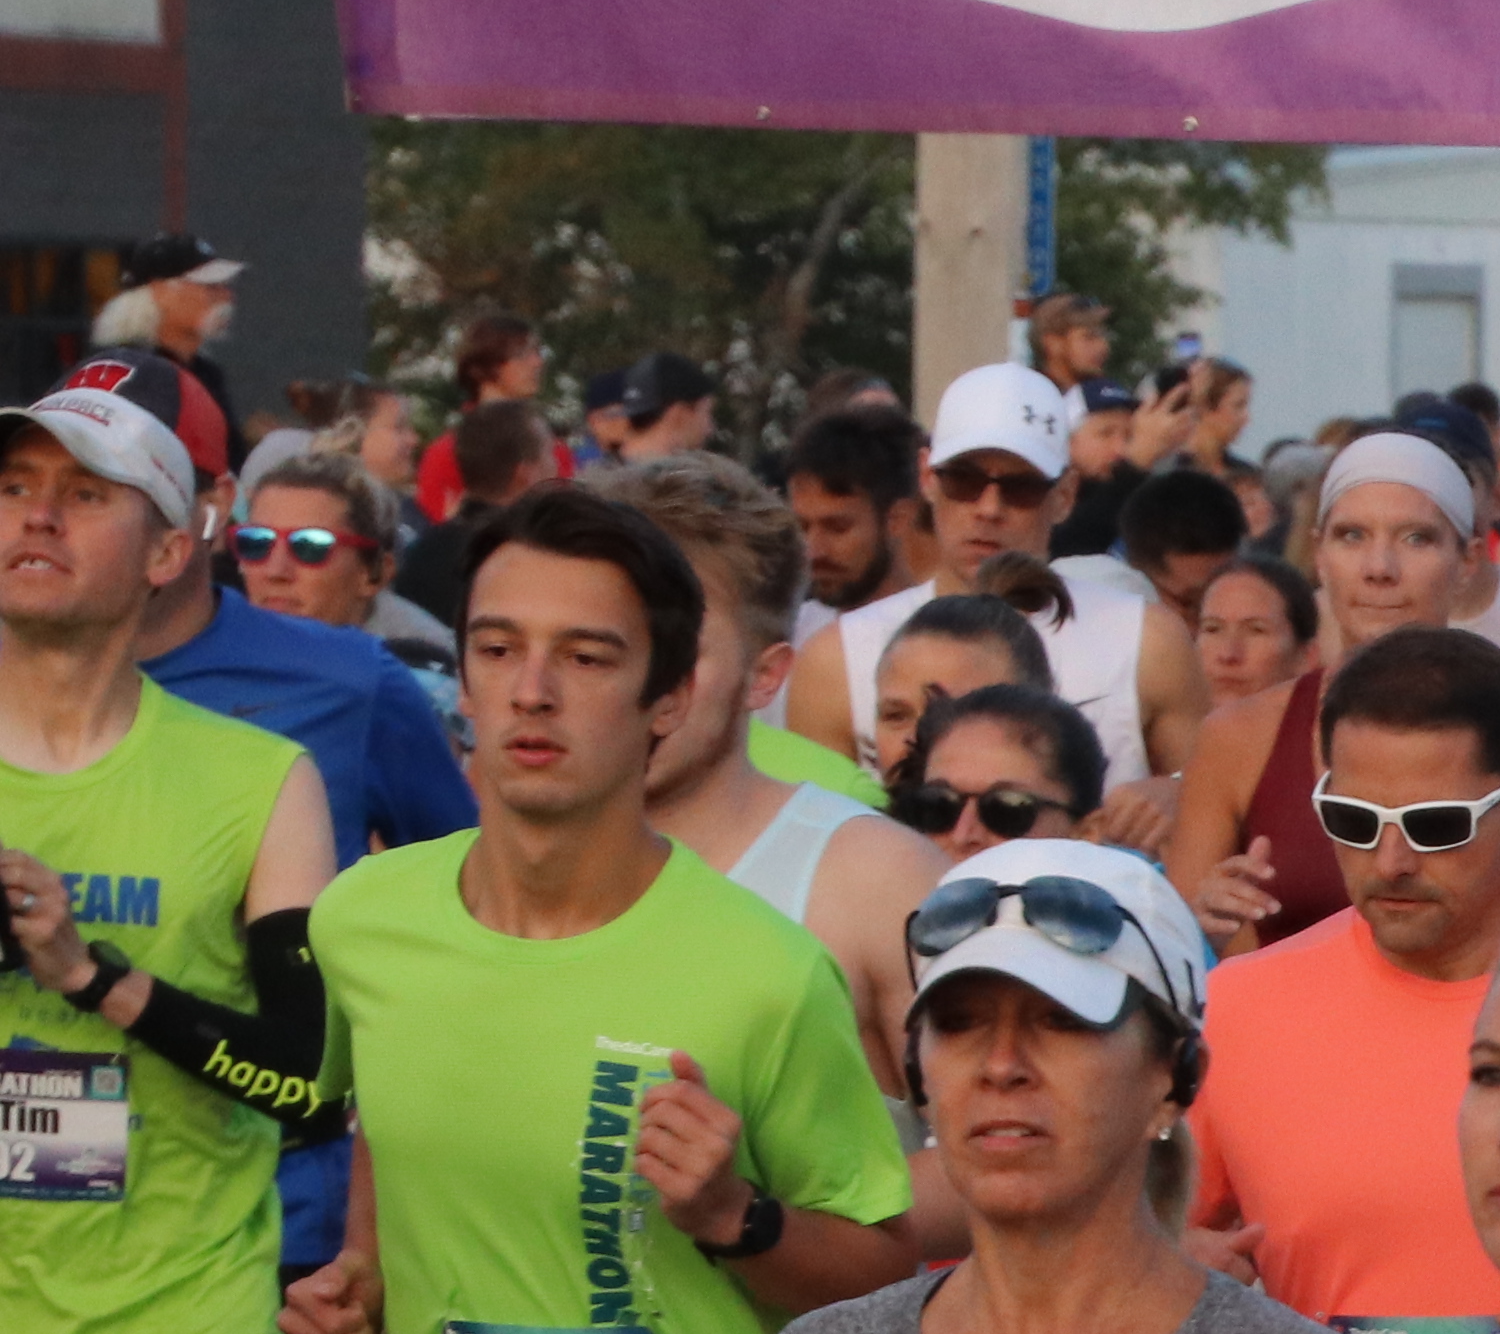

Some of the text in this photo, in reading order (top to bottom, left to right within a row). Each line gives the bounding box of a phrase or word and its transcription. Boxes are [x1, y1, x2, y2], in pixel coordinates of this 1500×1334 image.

[0, 1099, 60, 1134] Tim
[203, 1038, 322, 1119] happy
[579, 1059, 640, 1325] MARATHON
